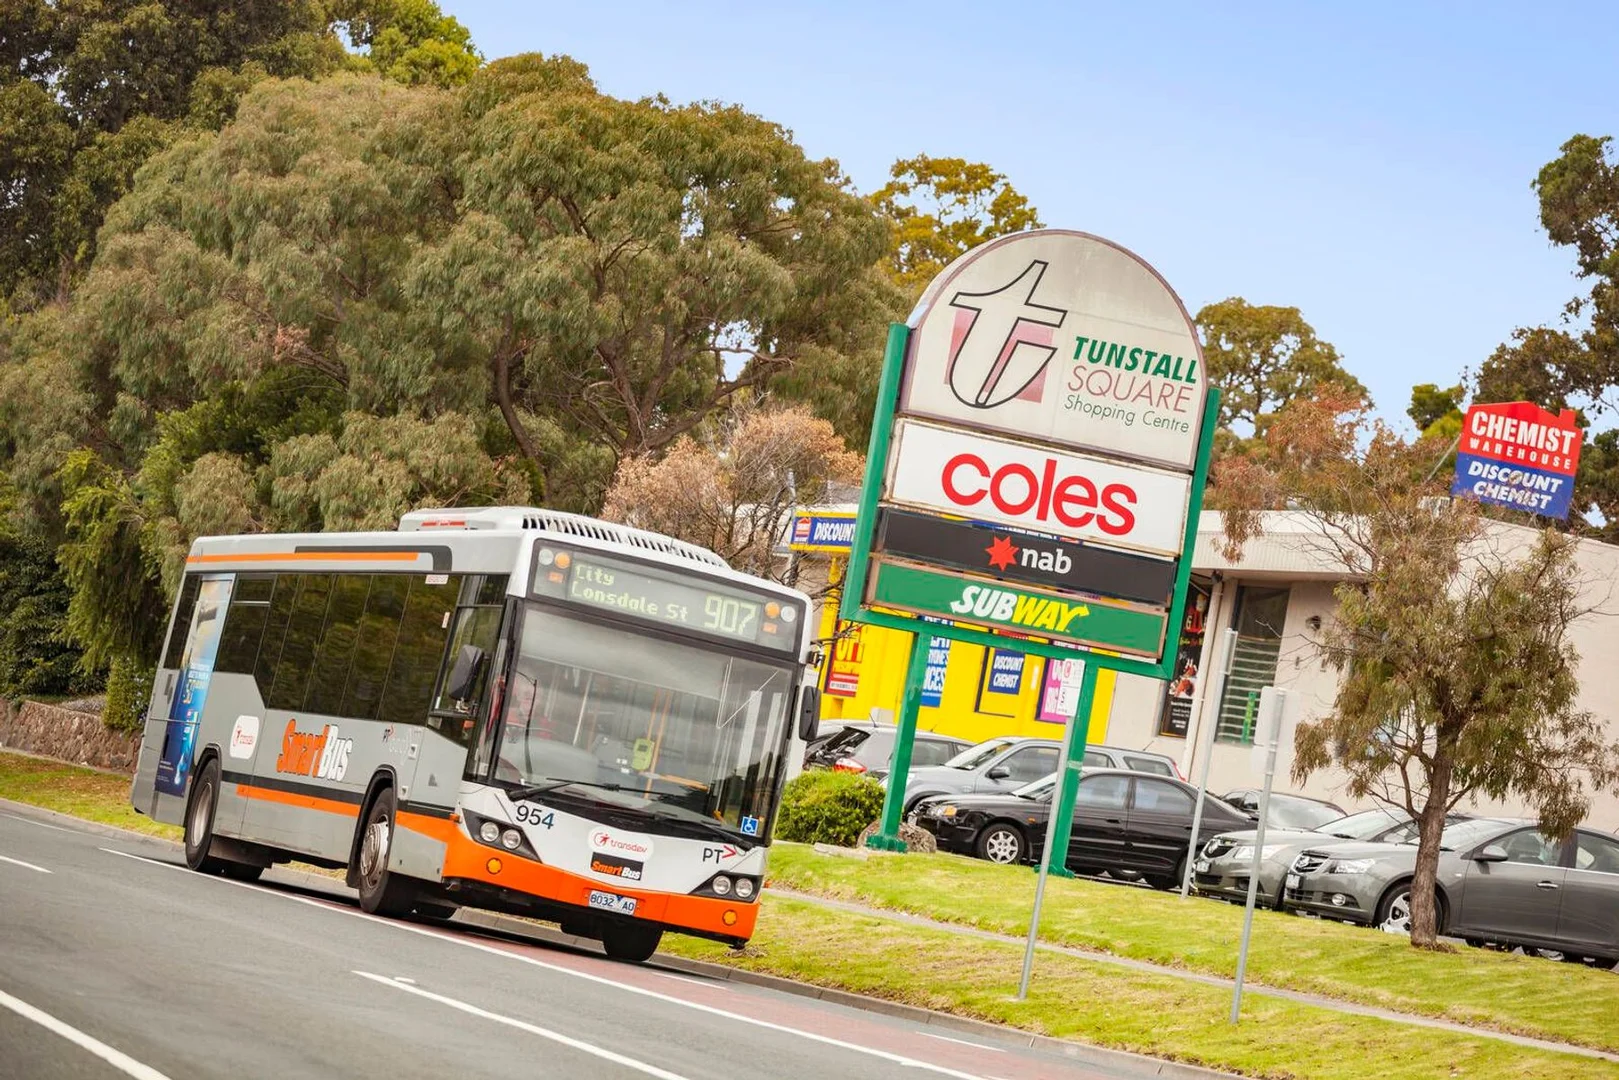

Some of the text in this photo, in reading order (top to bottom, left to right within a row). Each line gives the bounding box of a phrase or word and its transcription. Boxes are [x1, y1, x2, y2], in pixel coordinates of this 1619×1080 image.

[1072, 336, 1197, 384] TUNSTALL
[1068, 365, 1194, 413] SQUARE
[1064, 394, 1190, 433] Shopping Centre
[1471, 411, 1576, 455] CHEMIST
[1469, 437, 1571, 470] WAREHOUSE
[941, 452, 1138, 536] coles
[1468, 460, 1563, 493] DISCOUNT
[1473, 481, 1552, 510] CHEMIST
[574, 563, 614, 586] City
[1021, 547, 1072, 574] nab
[570, 580, 688, 622] Lonsdale St
[704, 594, 757, 635] 907
[950, 585, 1090, 632] SUBWAY
[993, 655, 1024, 671] DISCOUNT
[515, 804, 554, 830] 954
[610, 839, 648, 853] transdev
